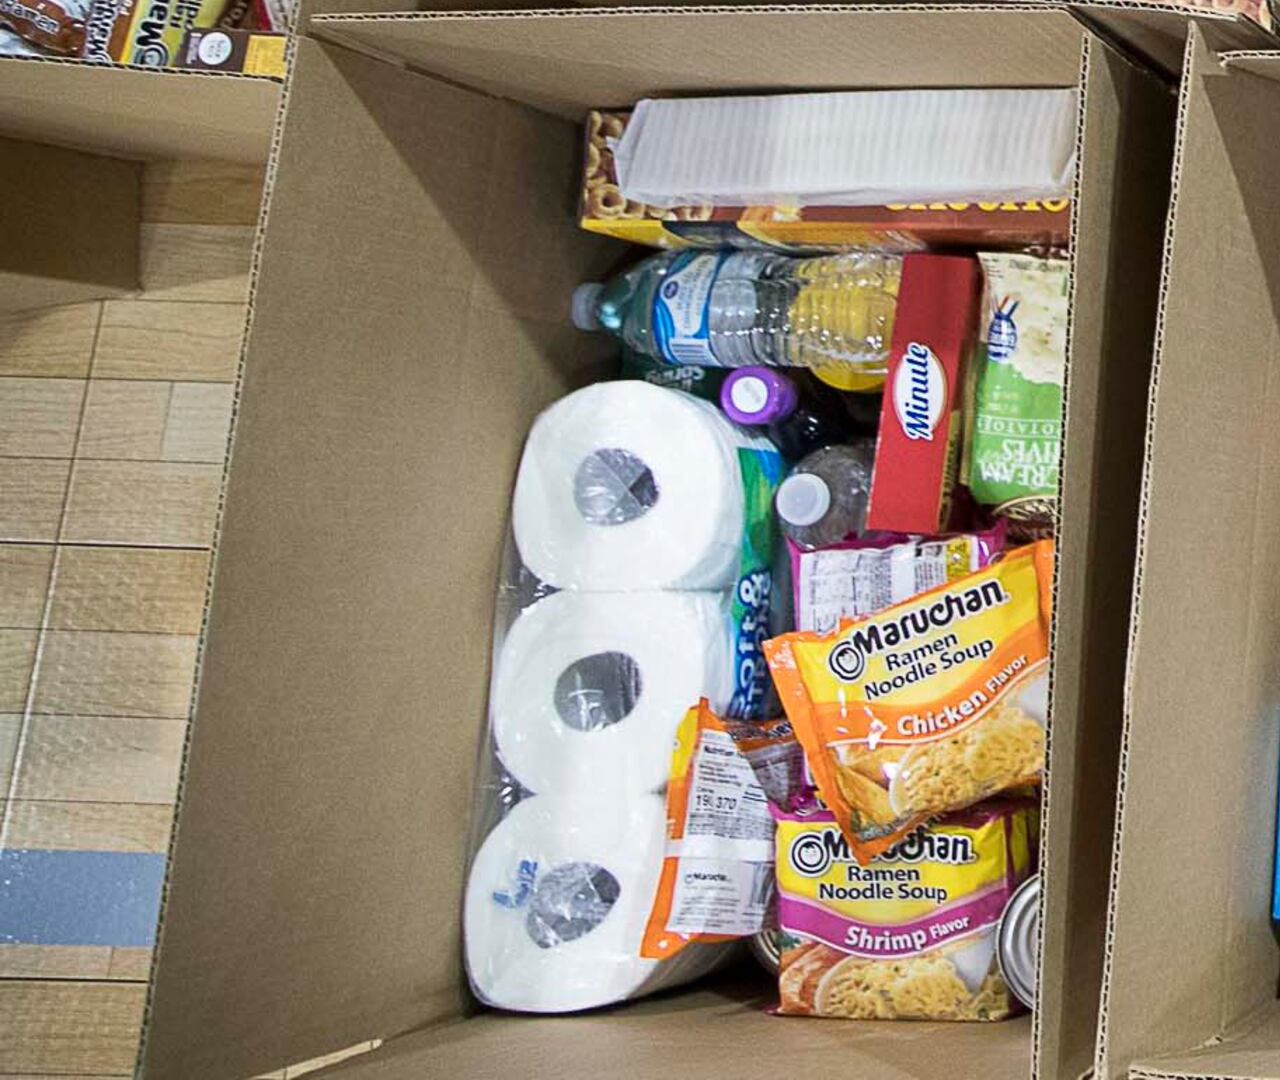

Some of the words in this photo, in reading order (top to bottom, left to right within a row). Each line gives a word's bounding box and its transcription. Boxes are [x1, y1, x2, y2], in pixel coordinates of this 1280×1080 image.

[905, 343, 931, 439] Minute
[981, 459, 1058, 489] CREAM
[856, 578, 1004, 654] Maruchan
[865, 656, 938, 701] Noodle
[939, 637, 994, 669] Soup
[886, 632, 959, 671] Ramen
[896, 688, 986, 736] Chicken
[986, 652, 1028, 694] Flavor
[716, 795, 738, 811] 370
[847, 866, 921, 882] Ramen
[819, 883, 894, 900] Noodle
[898, 885, 948, 904] Soup
[845, 925, 929, 953] Shrimp
[930, 916, 970, 940] Flavor
